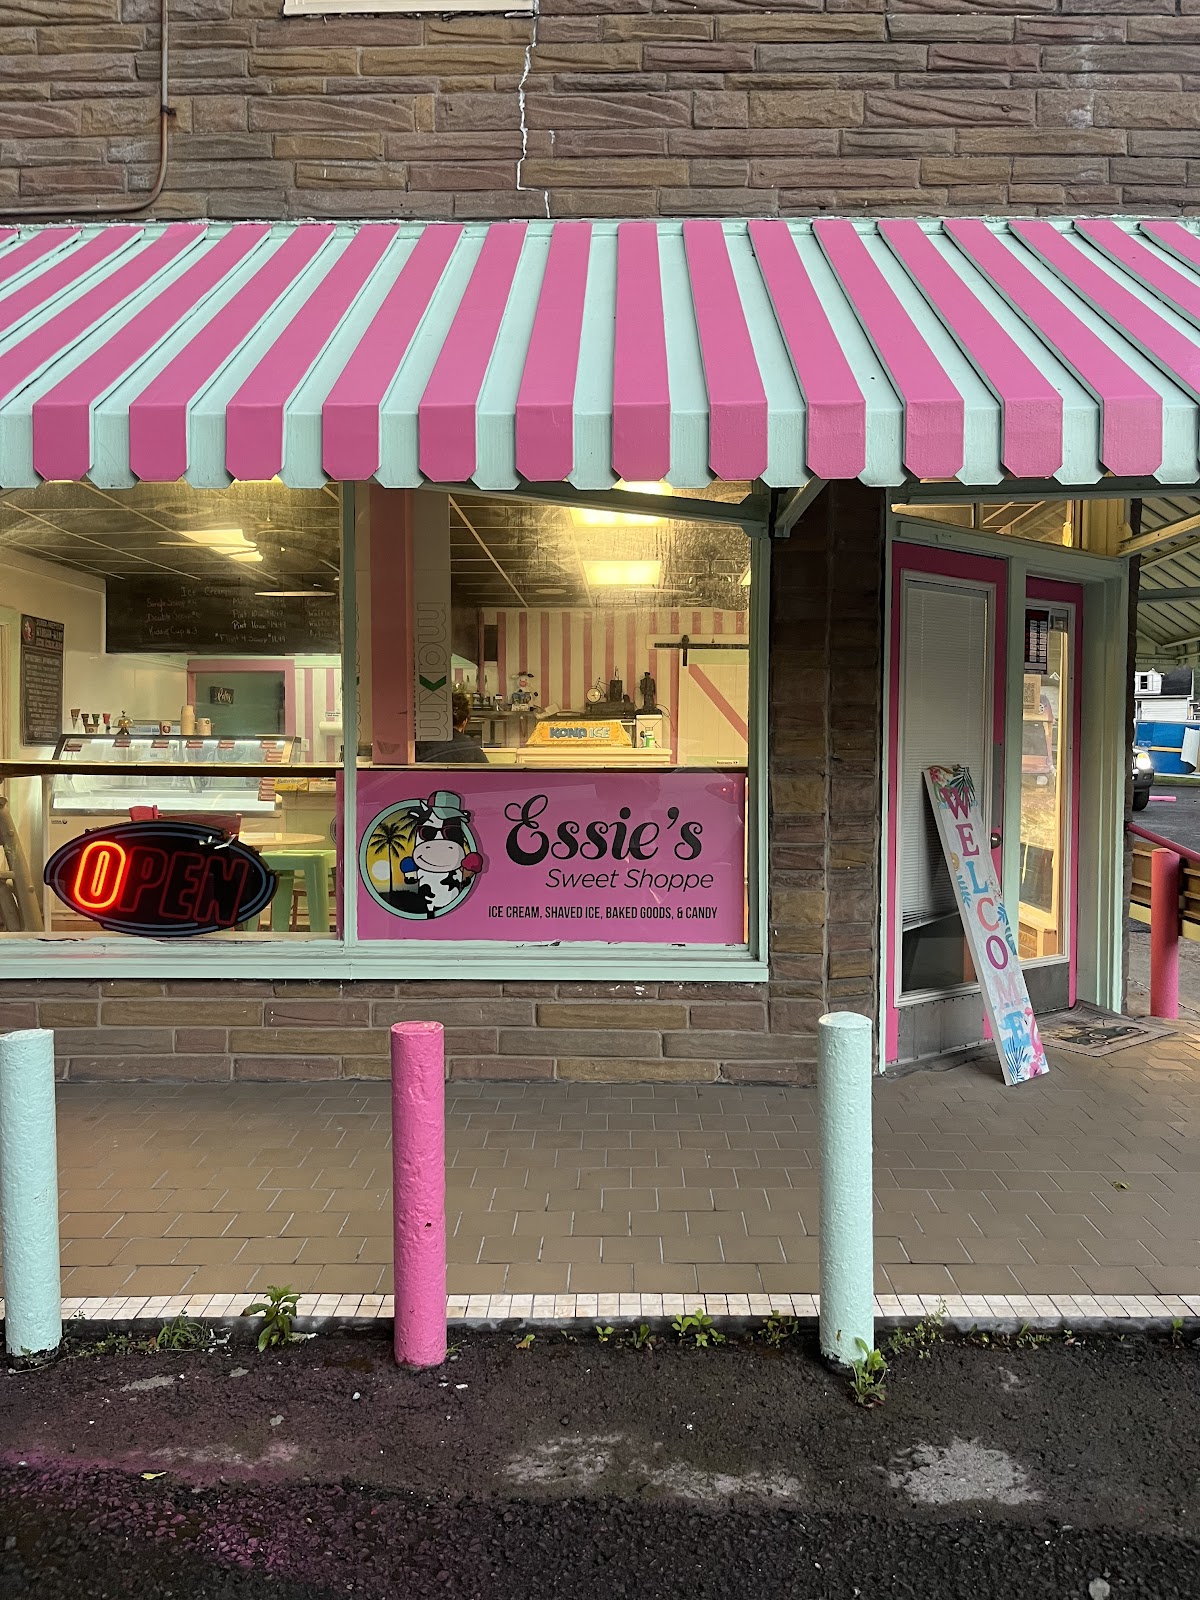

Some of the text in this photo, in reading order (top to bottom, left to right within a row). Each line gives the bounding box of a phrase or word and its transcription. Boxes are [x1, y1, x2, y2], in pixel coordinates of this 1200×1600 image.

[549, 726, 611, 739] KONA ICE
[504, 794, 704, 866] Essie's
[73, 840, 249, 925] OPEN
[545, 868, 714, 892] Sweet Shoppe
[488, 905, 718, 920] ICE CREAM, SHAVED ICE, BAKED GOODS, & CANDY
[939, 785, 1030, 1051] WELCOME
